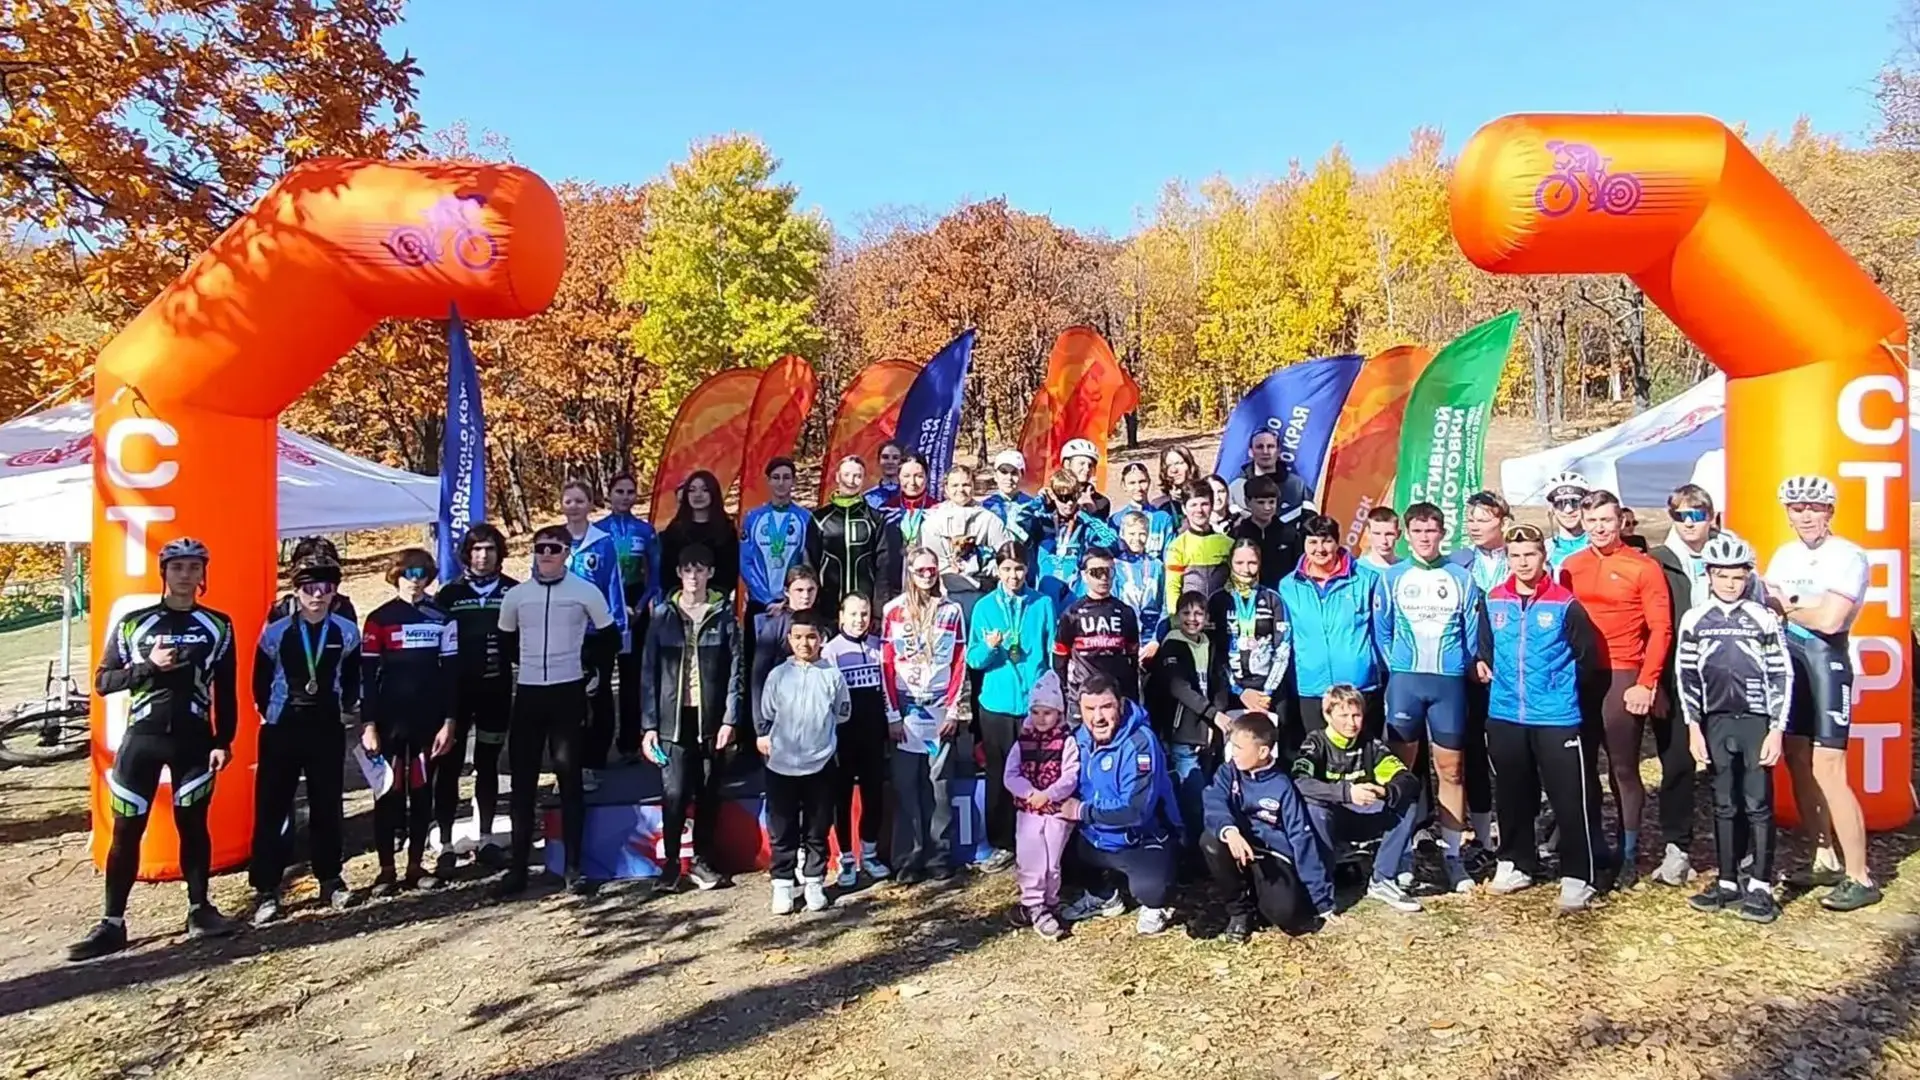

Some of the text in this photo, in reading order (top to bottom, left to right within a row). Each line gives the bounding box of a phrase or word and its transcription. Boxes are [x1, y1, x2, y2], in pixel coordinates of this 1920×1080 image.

[1283, 406, 1311, 449] КРАЯ
[1425, 406, 1453, 504] РТИВНОЙ
[1346, 494, 1374, 553] ОВСК
[145, 633, 208, 645] MERIDA
[1080, 616, 1122, 633] UAE
[950, 795, 973, 846] 1
